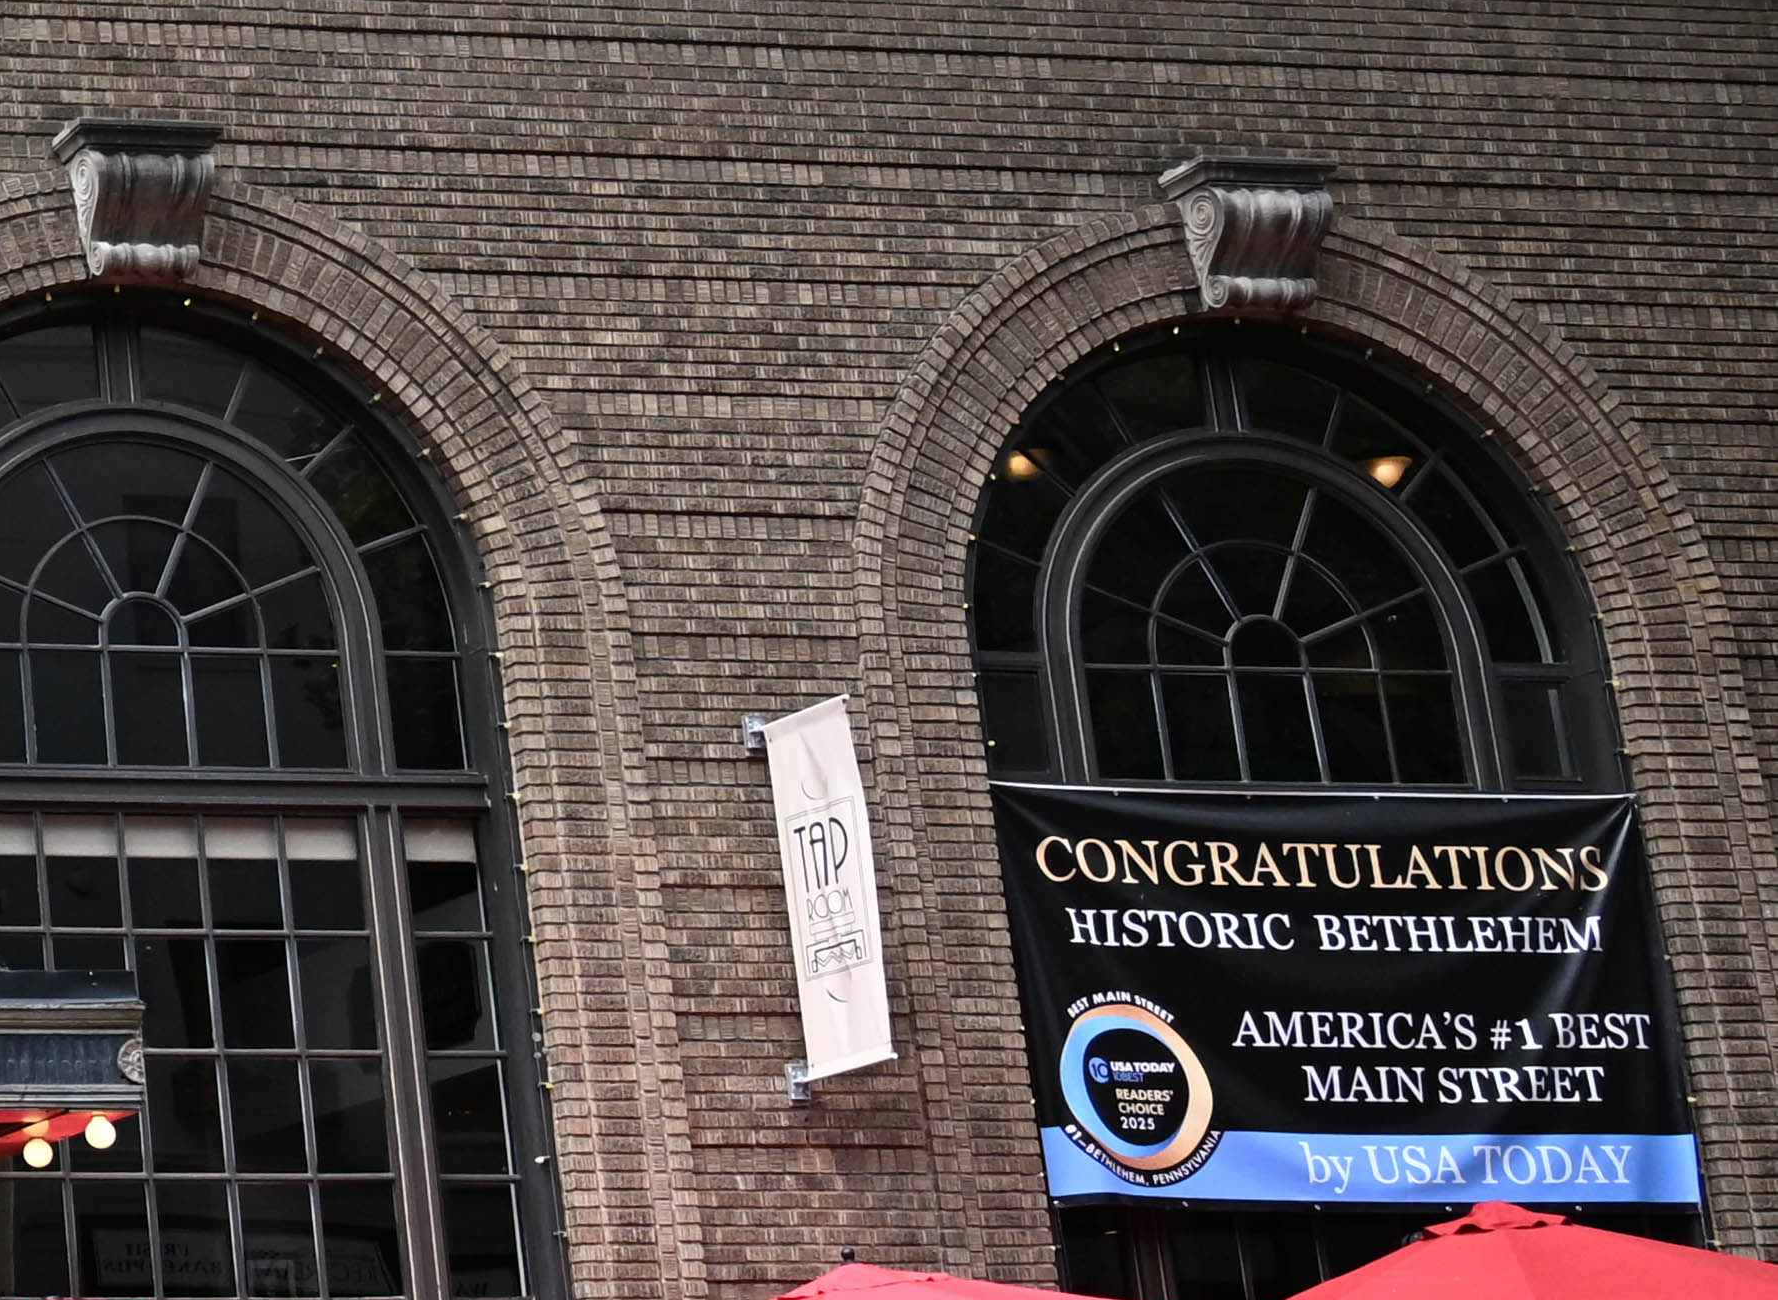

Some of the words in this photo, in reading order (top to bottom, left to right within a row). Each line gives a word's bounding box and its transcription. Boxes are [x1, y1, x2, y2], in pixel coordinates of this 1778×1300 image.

[794, 817, 848, 893] TAP
[1035, 835, 1610, 892] CONGRATULATIONS
[806, 888, 853, 923] ROOM
[1065, 907, 1295, 951] HISTORIC
[1316, 914, 1604, 954] BETHLEHEM
[1067, 996, 1090, 1018] BEST
[1092, 991, 1131, 1005] MAIN
[1134, 995, 1174, 1024] STREET
[1232, 1010, 1477, 1051] AMERICA'S
[1490, 1017, 1544, 1050] #1
[1552, 1012, 1651, 1051] BEST
[1303, 1066, 1426, 1104] MAIN
[1438, 1066, 1605, 1104] STREET
[1118, 1102, 1165, 1116] CHOICE
[1120, 1116, 1156, 1130] 2025
[1153, 1130, 1221, 1185] PENNSYLVANIA
[1302, 1141, 1353, 1194] by
[1368, 1143, 1463, 1185] USA
[1473, 1144, 1632, 1186] TODAY
